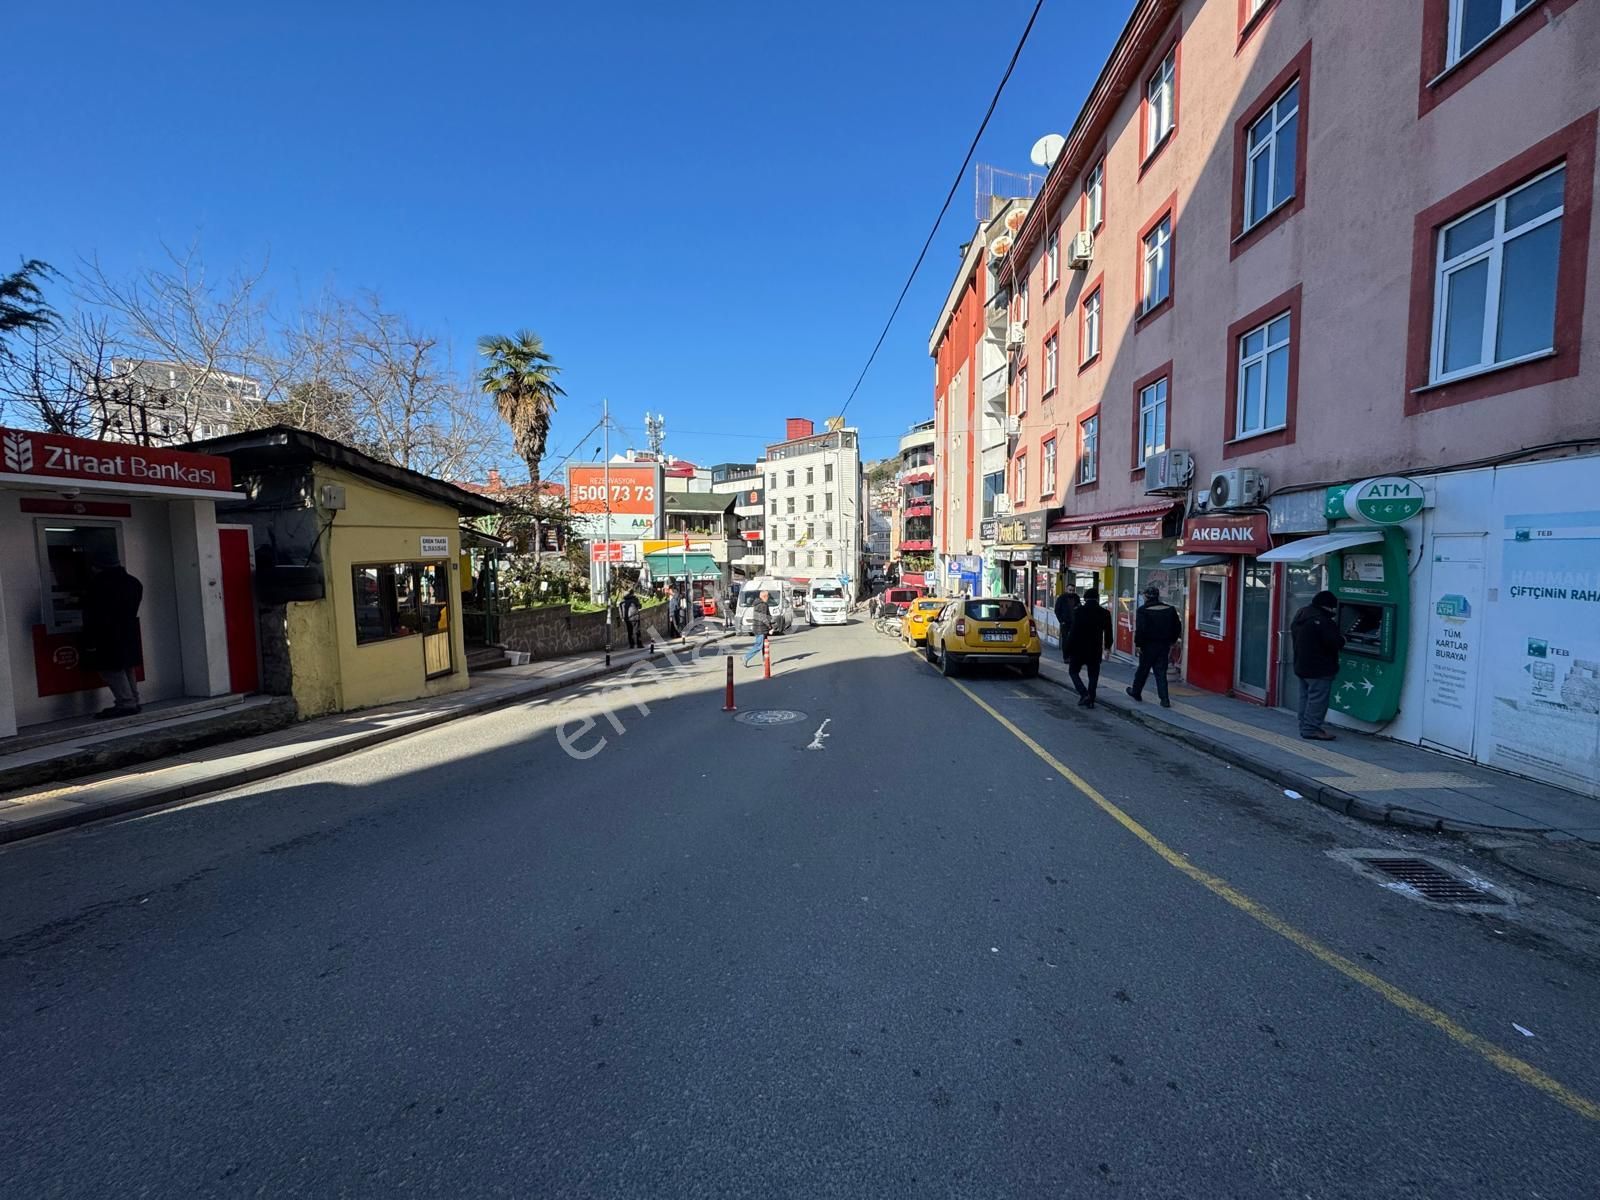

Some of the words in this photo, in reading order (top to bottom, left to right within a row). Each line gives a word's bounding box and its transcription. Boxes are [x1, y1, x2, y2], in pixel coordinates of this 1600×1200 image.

[43, 444, 127, 477] Ziraat
[130, 456, 217, 486] Bankası
[589, 476, 636, 485] REZEVASYON
[578, 485, 607, 501] 500
[611, 485, 631, 502] 73
[634, 486, 655, 502] 73
[1368, 484, 1411, 498] ATM
[1191, 527, 1255, 541] AKBANK
[1509, 585, 1569, 600] ÇİFTÇİNİN
[1443, 628, 1462, 639] TÜM
[1435, 639, 1469, 652] KARTLAR
[1549, 647, 1570, 657] TEB
[1435, 649, 1467, 662] BURAYA!
